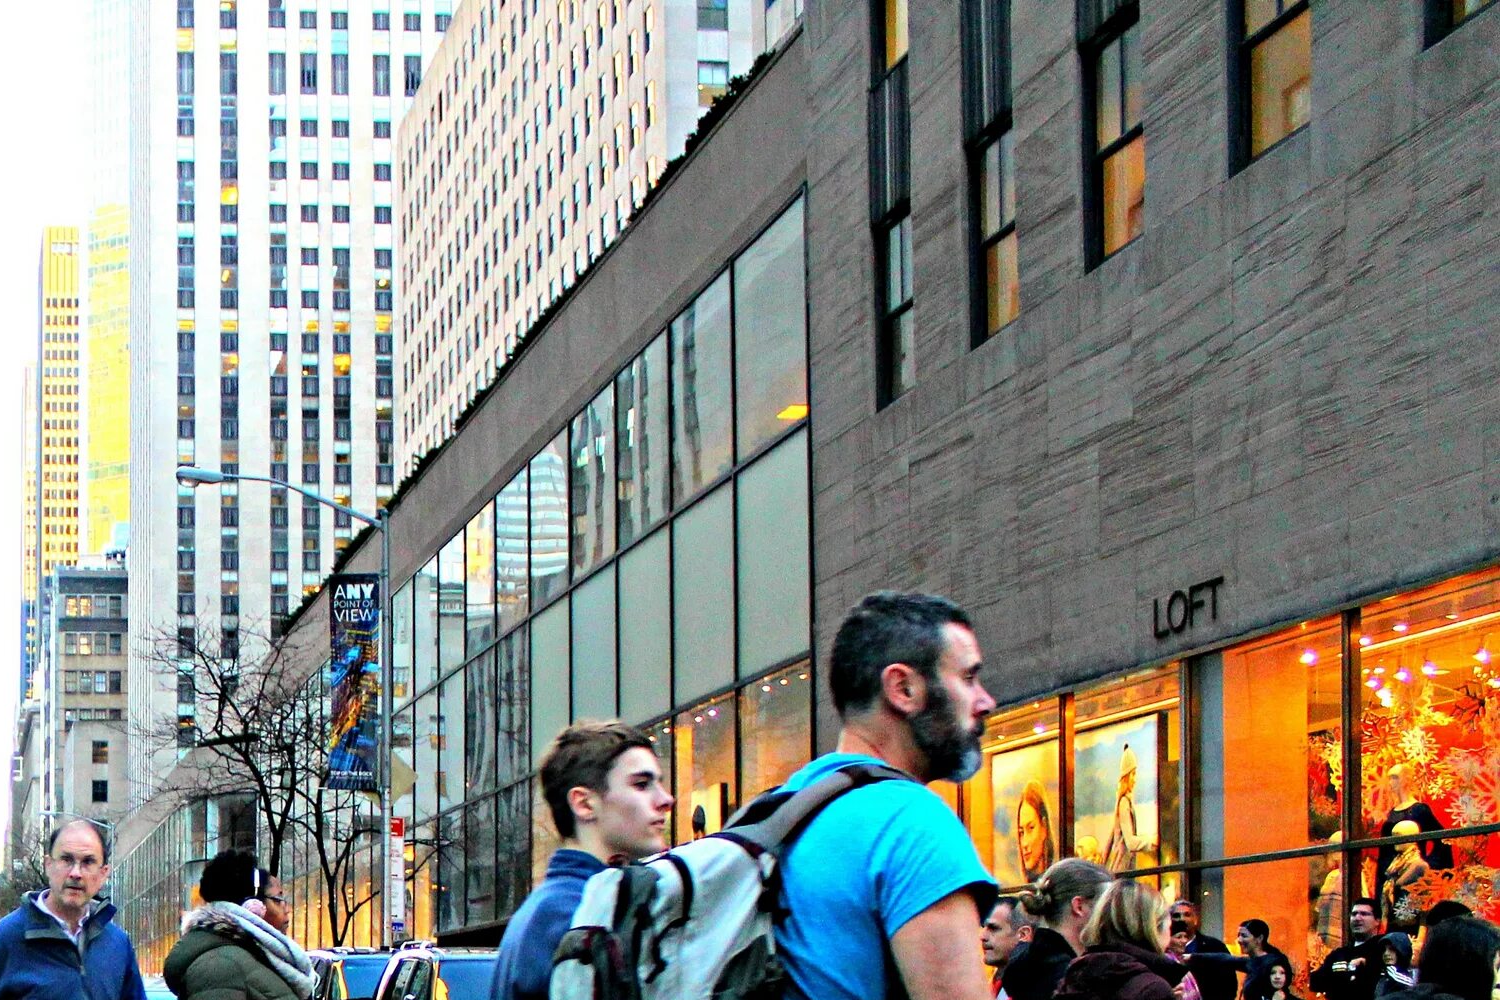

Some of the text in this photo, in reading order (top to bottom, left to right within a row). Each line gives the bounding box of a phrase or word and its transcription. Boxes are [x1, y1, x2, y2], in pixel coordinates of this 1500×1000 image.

[334, 583, 374, 599] ANY
[333, 600, 374, 608] POINT OF
[1153, 575, 1225, 638] LOFT
[334, 608, 374, 622] VIEW
